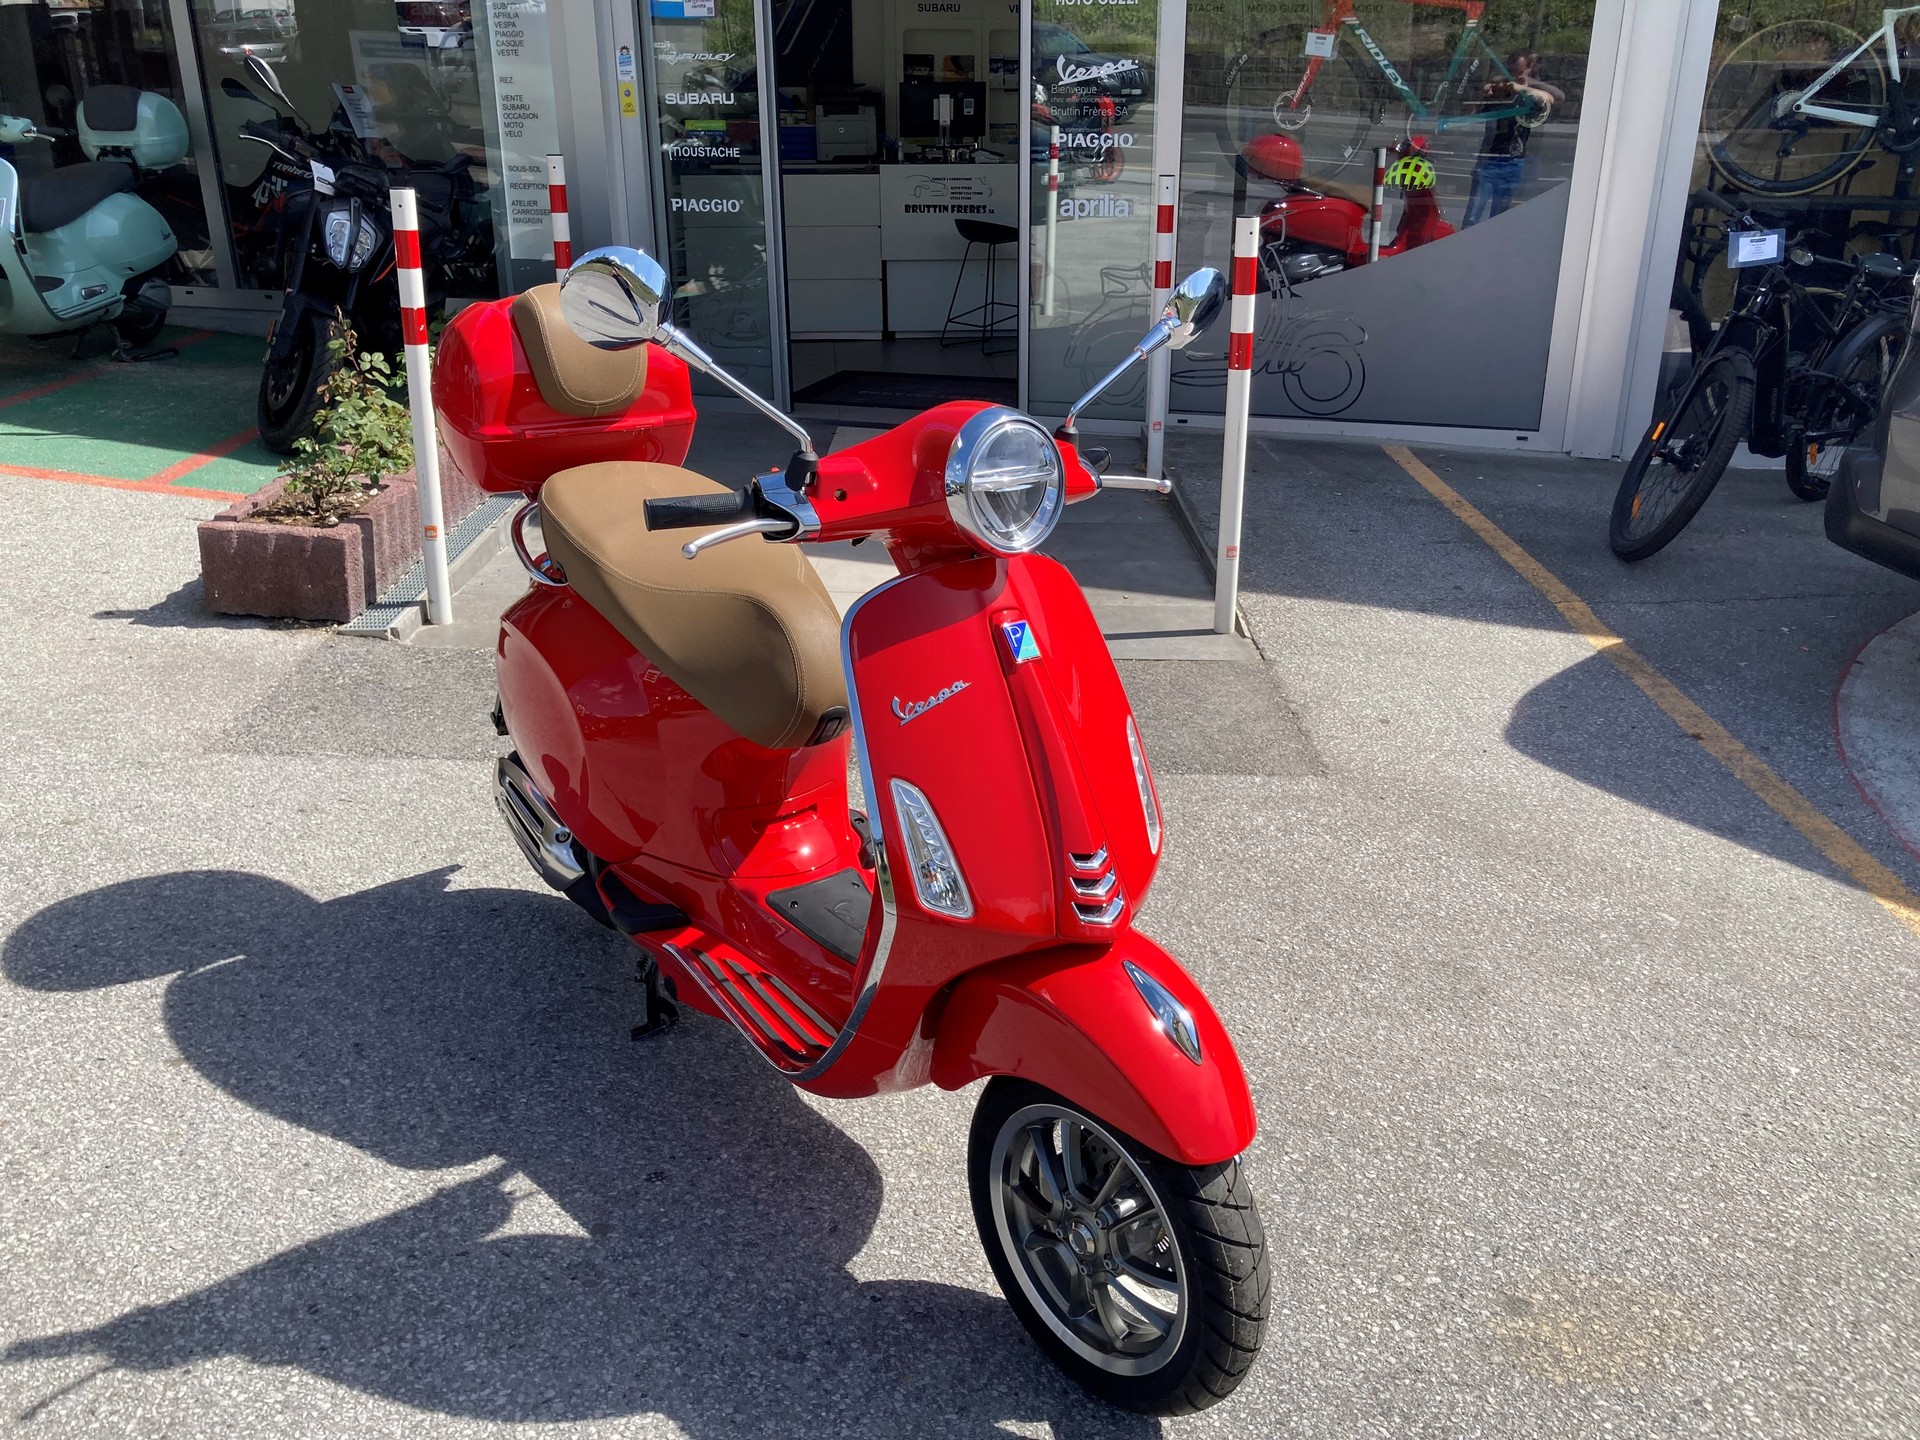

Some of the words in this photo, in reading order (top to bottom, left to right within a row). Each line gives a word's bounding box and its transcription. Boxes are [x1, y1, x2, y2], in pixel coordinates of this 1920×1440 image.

[917, 3, 960, 12] SUBARU
[1355, 28, 1410, 92] RIDLEY
[1056, 54, 1139, 86] Vespa
[1051, 84, 1097, 94] Bienvenue
[665, 93, 737, 105] SUBARU
[1050, 106, 1081, 116] Bruttin
[1083, 105, 1112, 117] Frères
[1115, 107, 1129, 116] SA
[504, 121, 524, 129] MOTO
[1056, 133, 1134, 148] PIAGGIO
[508, 165, 542, 173] SOUS-SOL
[670, 198, 741, 213] PIAGGIO
[904, 204, 949, 214] BRUTTIN
[950, 204, 987, 214] FRERES
[1059, 193, 1129, 220] aprilia
[513, 217, 543, 225] MAGASIN
[891, 680, 972, 727] Vespa
